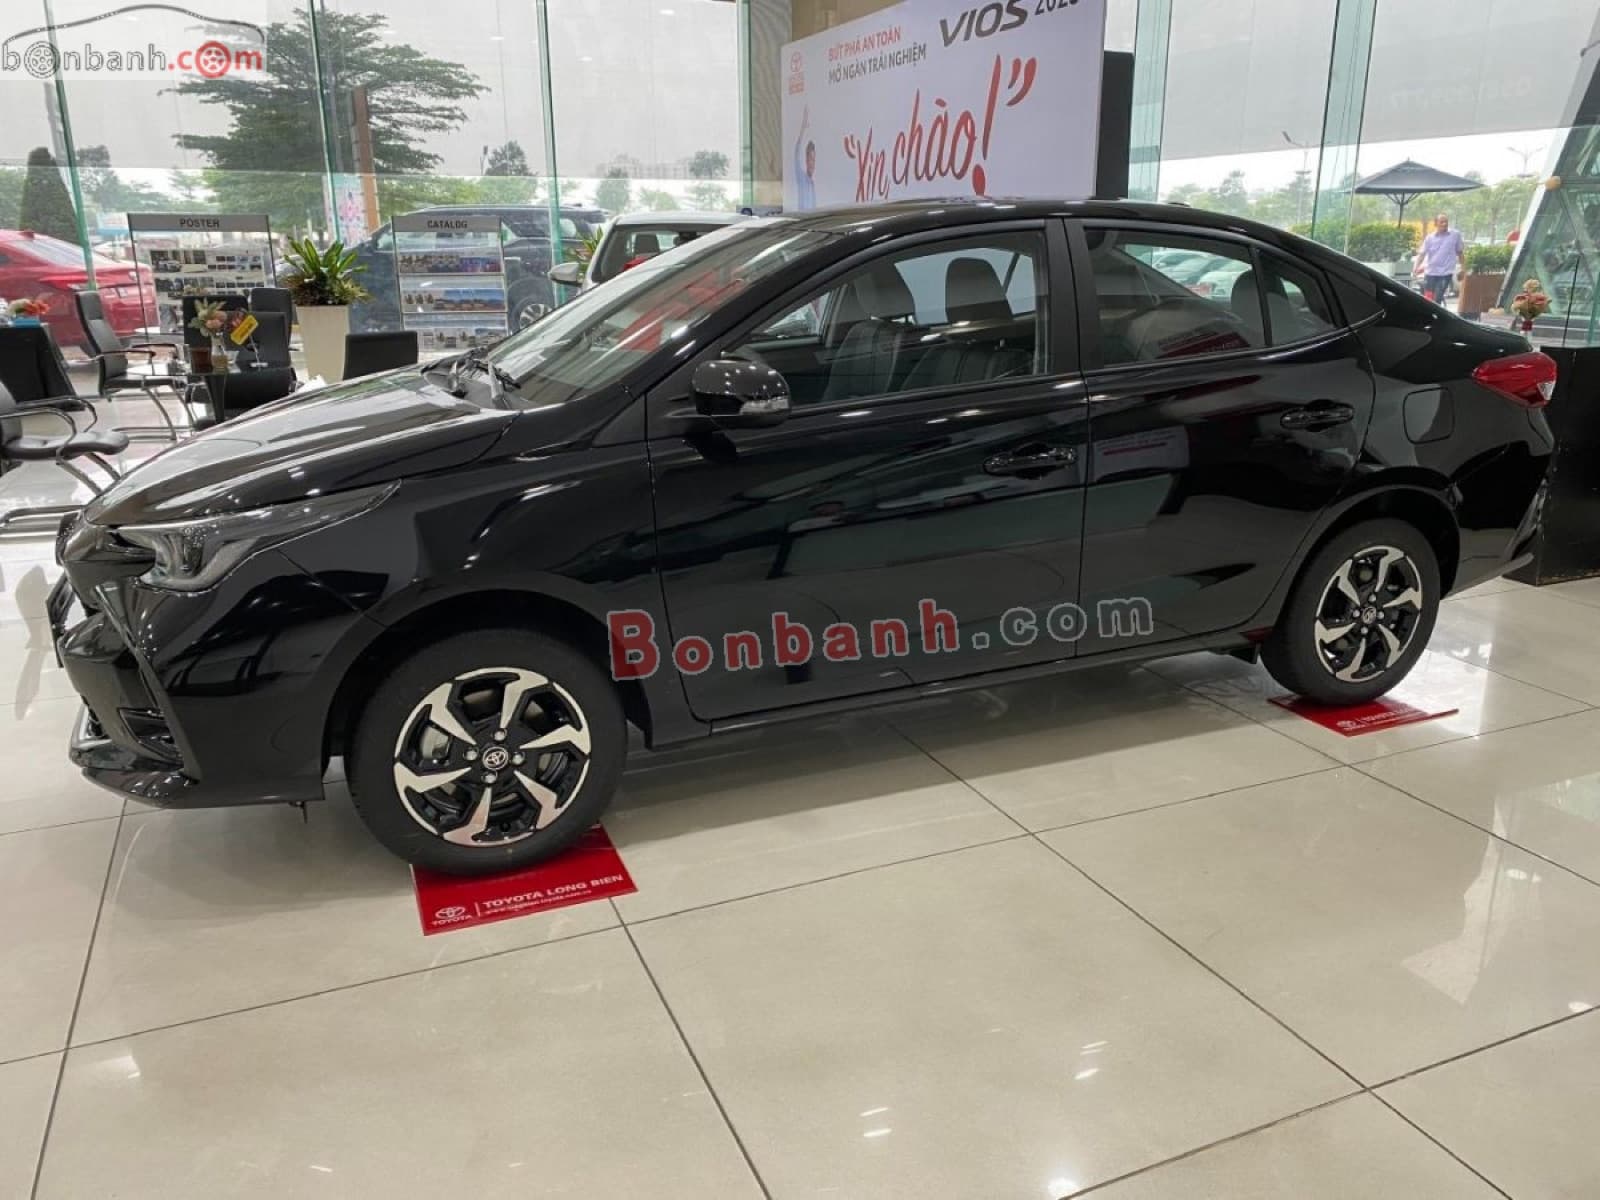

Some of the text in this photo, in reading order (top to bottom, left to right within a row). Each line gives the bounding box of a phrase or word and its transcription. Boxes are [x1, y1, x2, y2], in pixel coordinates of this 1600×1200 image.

[939, 0, 1028, 47] VIOS
[862, 35, 876, 52] AN
[179, 218, 220, 228] POSTER
[427, 220, 468, 230] CATALOG
[482, 892, 543, 909] TOYOTA
[546, 882, 587, 896] LONG
[590, 874, 624, 888] BIEN
[432, 915, 473, 926] TOYOTA
